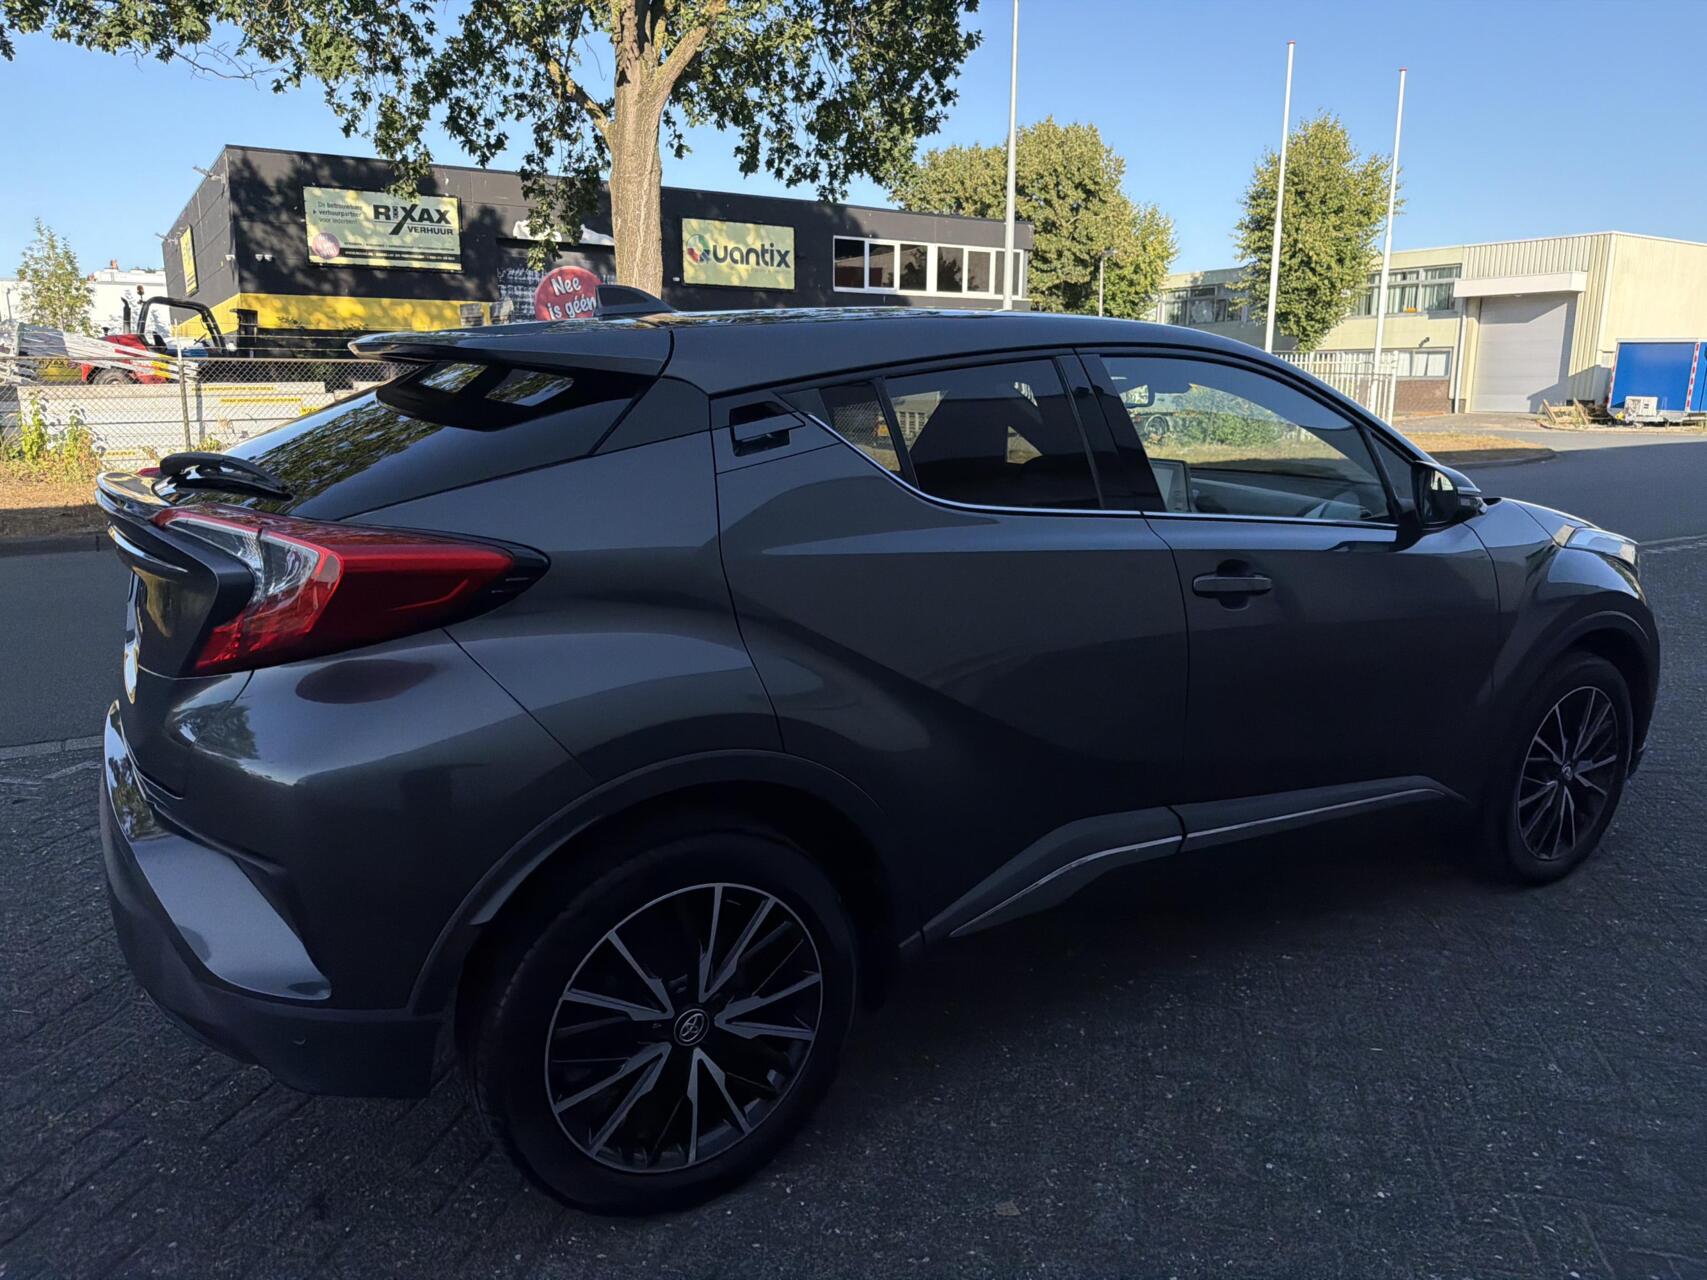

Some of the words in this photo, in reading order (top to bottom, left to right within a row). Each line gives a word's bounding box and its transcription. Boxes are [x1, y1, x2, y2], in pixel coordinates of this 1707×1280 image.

[373, 204, 452, 235] RIXAX
[407, 225, 454, 236] VERHUUR
[550, 275, 582, 296] Nee
[547, 302, 562, 320] is
[565, 293, 597, 319] géén
